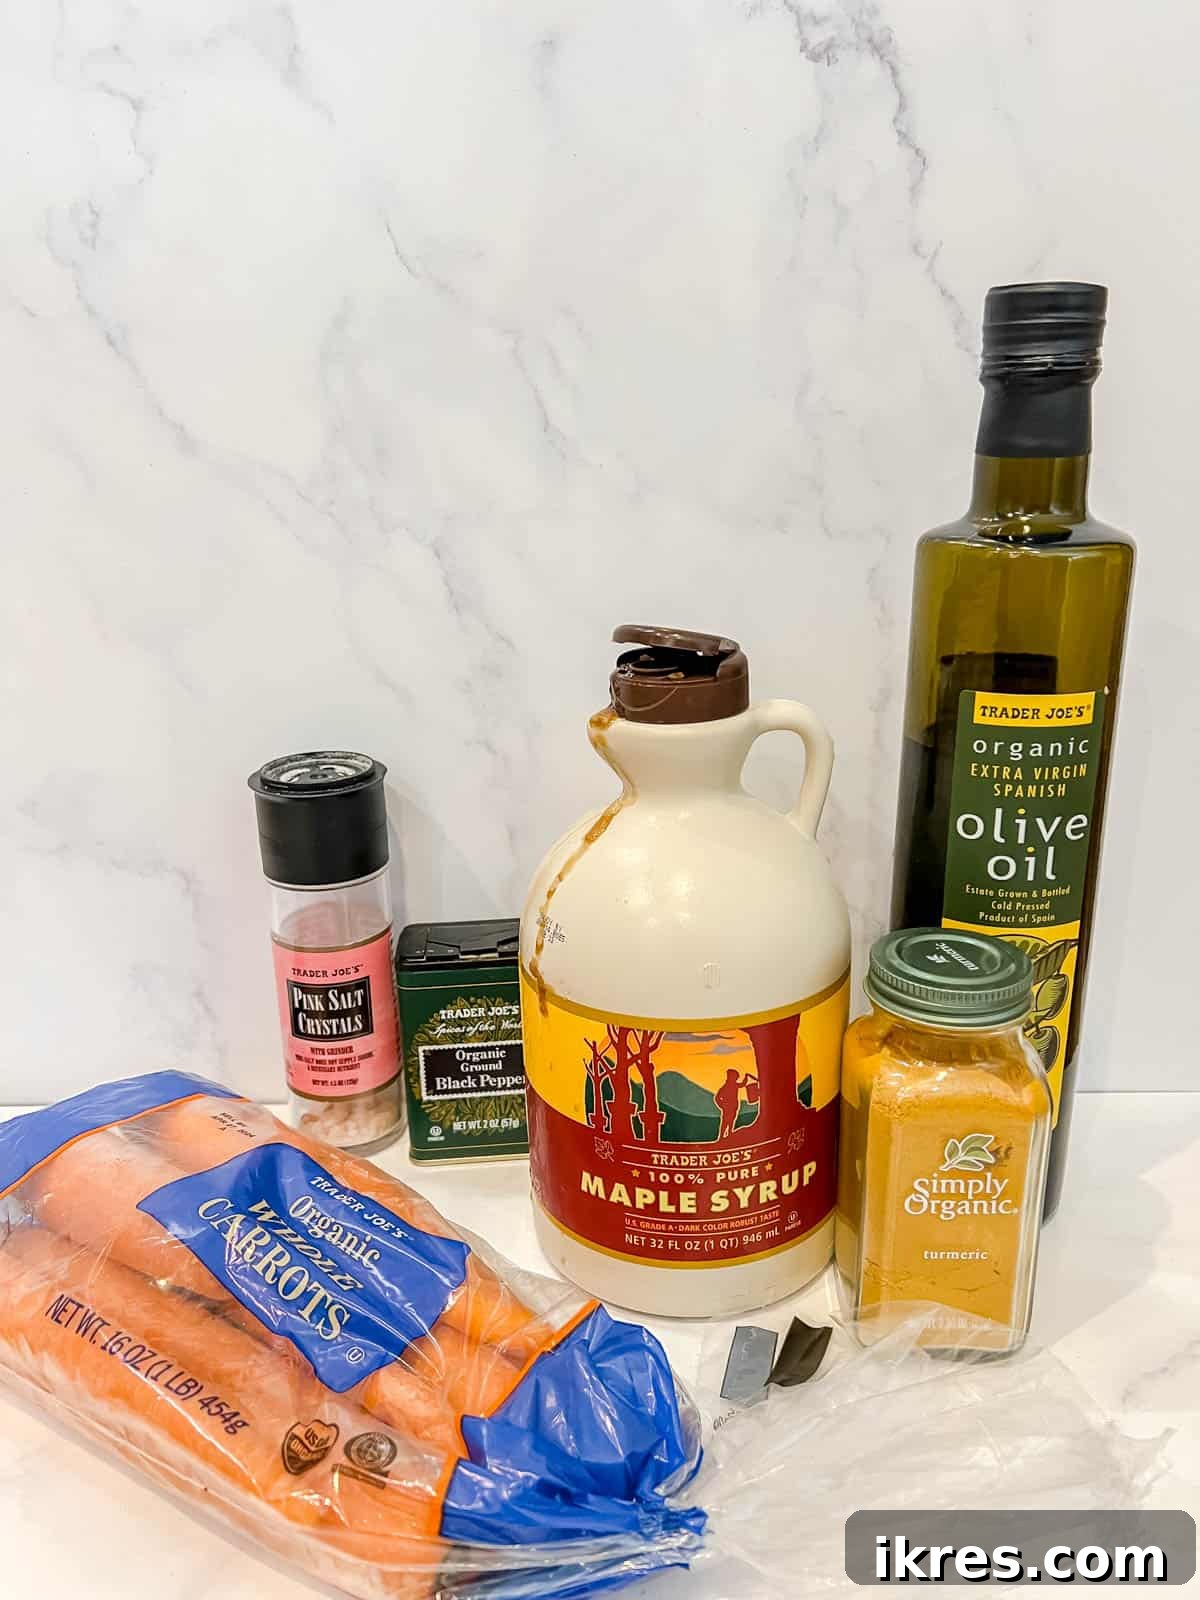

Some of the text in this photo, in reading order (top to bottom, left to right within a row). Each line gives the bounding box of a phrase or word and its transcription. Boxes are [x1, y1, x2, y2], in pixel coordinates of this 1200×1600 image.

[979, 704, 1086, 719] TRADER JOE'S
[972, 736, 1089, 761] organic
[970, 763, 1088, 780] EXTRA VIRGIN
[993, 783, 1066, 798] SPANISH
[956, 807, 1089, 844] olive
[986, 846, 1057, 881] oil
[965, 884, 1071, 899] Estate Grown & Bottled
[991, 900, 1051, 911] Cold Pressed
[979, 911, 1056, 924] Product of Spain
[291, 965, 361, 978] TRADER JOE'S
[439, 1005, 520, 1020] TRADER JOE'S
[455, 1047, 507, 1062] Organic
[460, 1060, 503, 1073] Ground
[434, 1075, 477, 1091] Black
[651, 1150, 753, 1167] TRADER JOE'S
[648, 1166, 760, 1185] 100% PURE
[580, 1160, 818, 1215] MAPLE SYRUP
[913, 1171, 1009, 1201] Simply
[310, 1176, 409, 1241] TRADER JOE'S
[639, 1221, 667, 1232] GRADE
[678, 1224, 701, 1233] DARK
[702, 1222, 729, 1232] COLOR
[730, 1216, 758, 1230] ROBUST
[759, 1210, 780, 1223] TASTE
[288, 1194, 383, 1270] Organic
[625, 1226, 781, 1252] NET 32 FL OZ (1 QT) 946 mL
[248, 1199, 364, 1292] WHOLE
[923, 1248, 989, 1260] turmeric
[198, 1197, 351, 1341] CARROTS
[44, 1293, 250, 1436] NET WT. 16 OZ (1 LB) 454g
